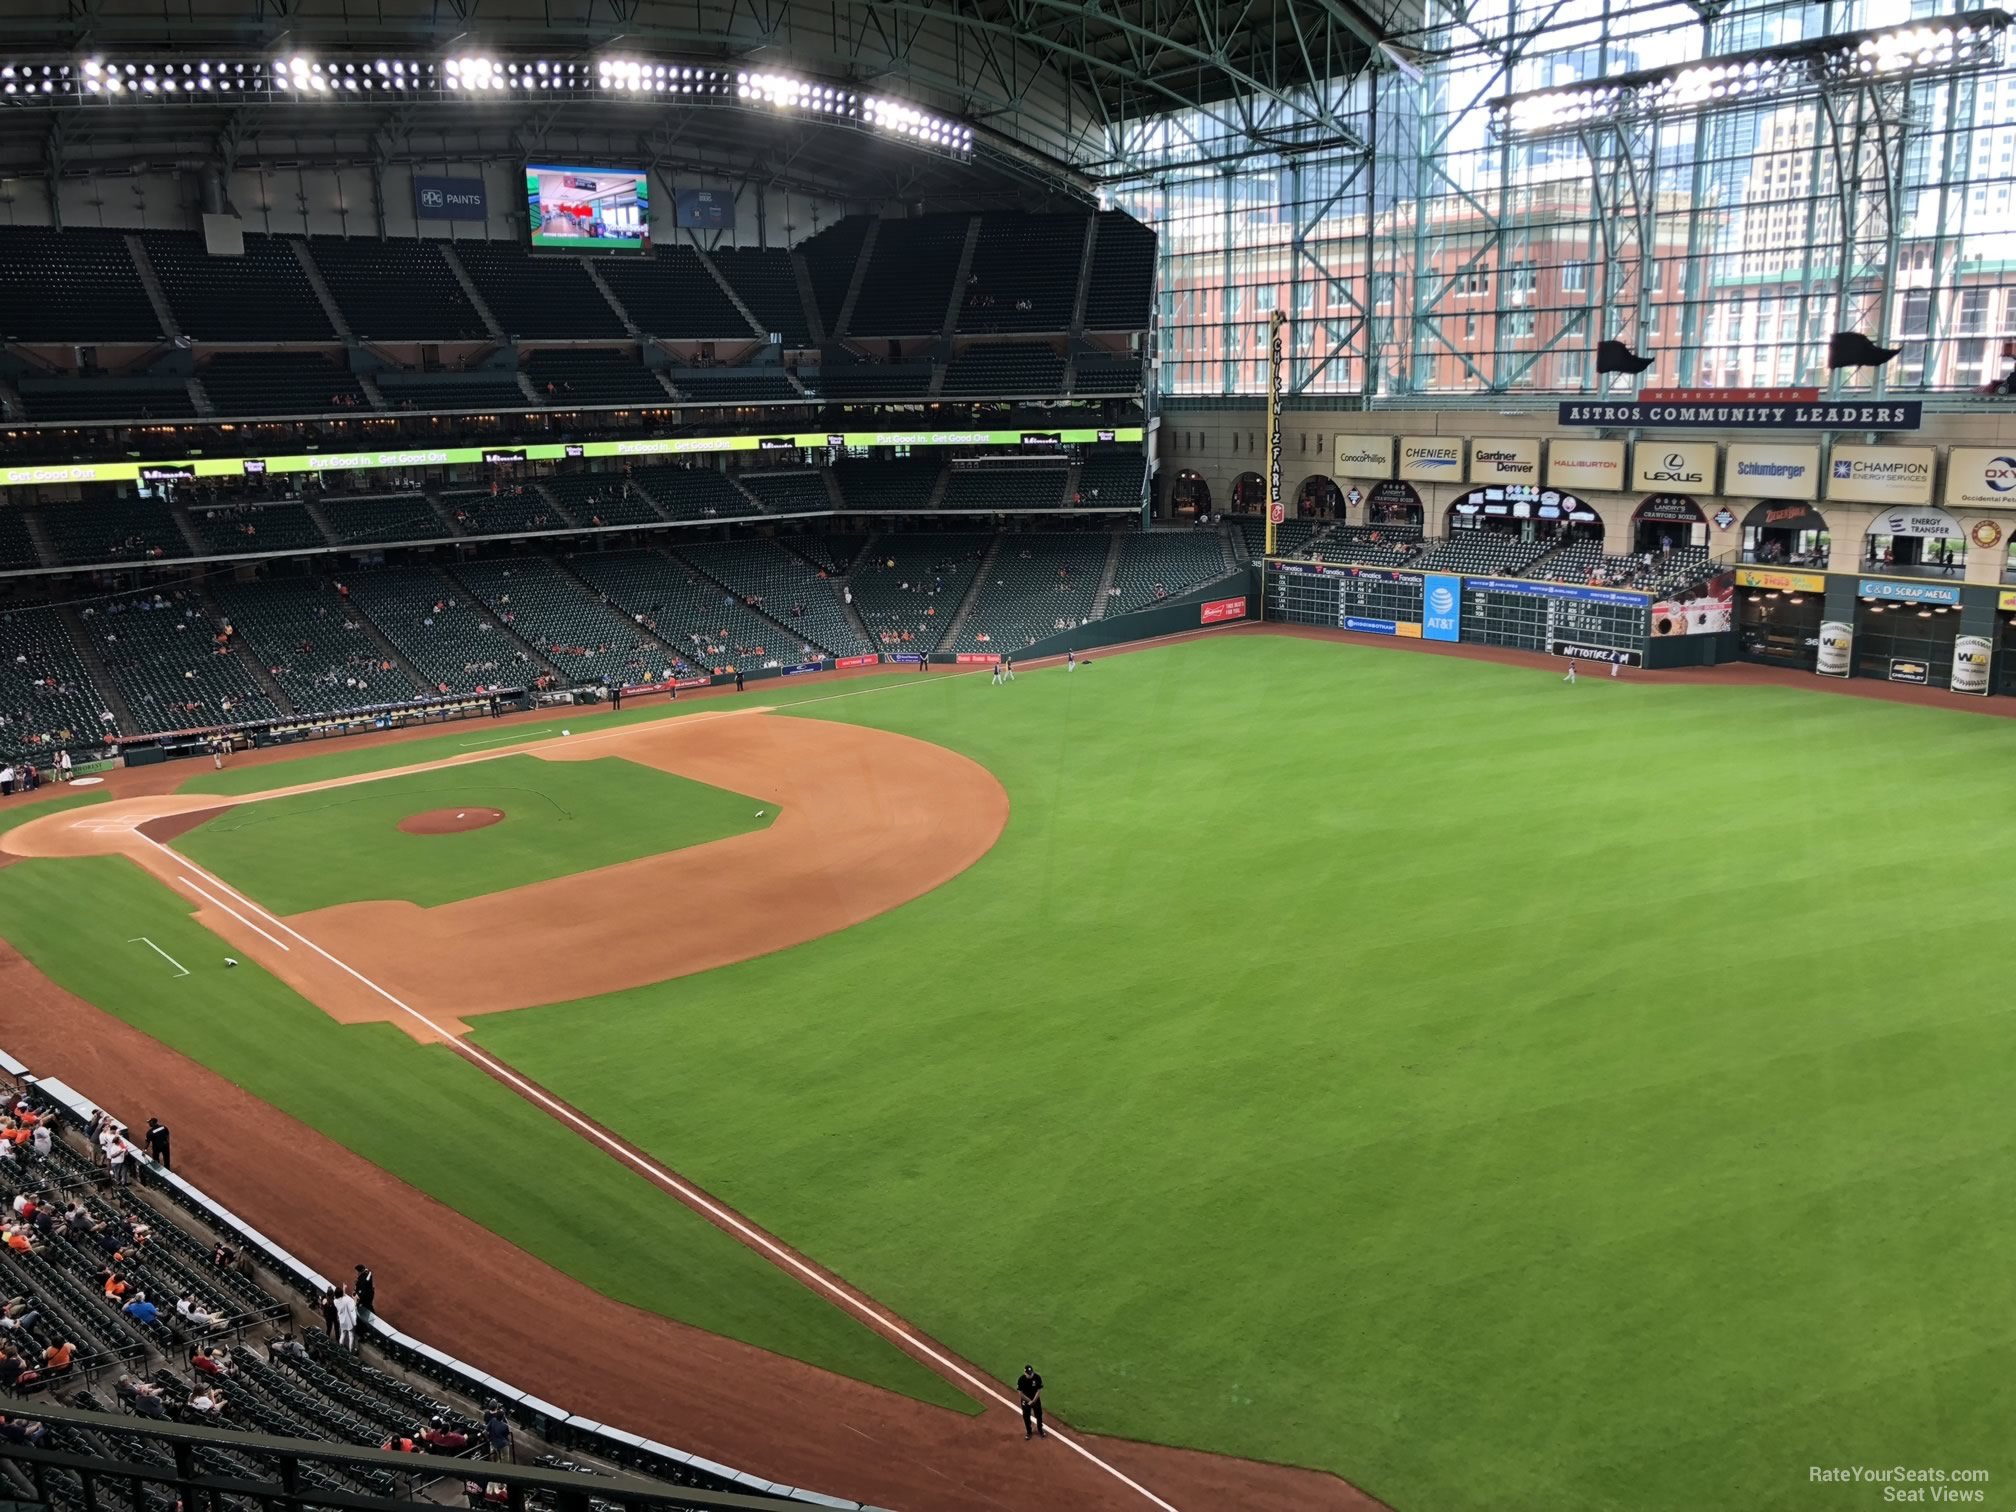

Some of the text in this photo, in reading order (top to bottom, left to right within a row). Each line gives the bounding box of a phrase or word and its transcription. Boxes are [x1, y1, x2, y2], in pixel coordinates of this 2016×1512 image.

[423, 192, 481, 205] PPG PAINTS
[1650, 407, 1785, 421] COMMUNITY
[1795, 407, 1905, 422] LEADERS
[877, 435, 893, 443] Put
[894, 434, 915, 443] Good
[932, 434, 949, 443] Get
[949, 433, 971, 442] Good
[972, 433, 990, 442] Out
[637, 443, 658, 452] Good
[692, 441, 713, 450] Good
[1340, 452, 1386, 464] ConocoPhillips
[1405, 448, 1458, 459] CHENIERE
[1476, 450, 1516, 461] Gardner
[310, 458, 330, 468] Put
[331, 456, 359, 466] Good
[379, 454, 397, 464] Get
[399, 454, 428, 463] Good
[429, 453, 448, 462] Out
[1554, 460, 1617, 469] HALLIBURTON
[1496, 462, 1533, 473] Denver
[1737, 462, 1805, 480] Schlumberger
[1853, 461, 1928, 473] CHAMPION
[8, 468, 96, 481] Get Good Out
[1272, 449, 1282, 501] FARE
[1644, 471, 1702, 482] LEXUS
[1886, 474, 1927, 482] SERVICES
[1643, 511, 1676, 519] CRAWFORD
[1911, 517, 1942, 526] ENERGY
[1911, 526, 1949, 534] TRANSFER
[1282, 564, 1303, 572] Fanatics
[1323, 567, 1345, 576] Fanatics
[1359, 571, 1382, 579] Fanatics
[1399, 574, 1422, 582] Fanatics
[1865, 584, 1953, 600] C & D SCRAP METAL
[1427, 618, 1455, 630] AT&T
[1805, 637, 1820, 646] 36
[1958, 652, 1987, 664] WM
[1891, 672, 1924, 681] CHEVROLET
